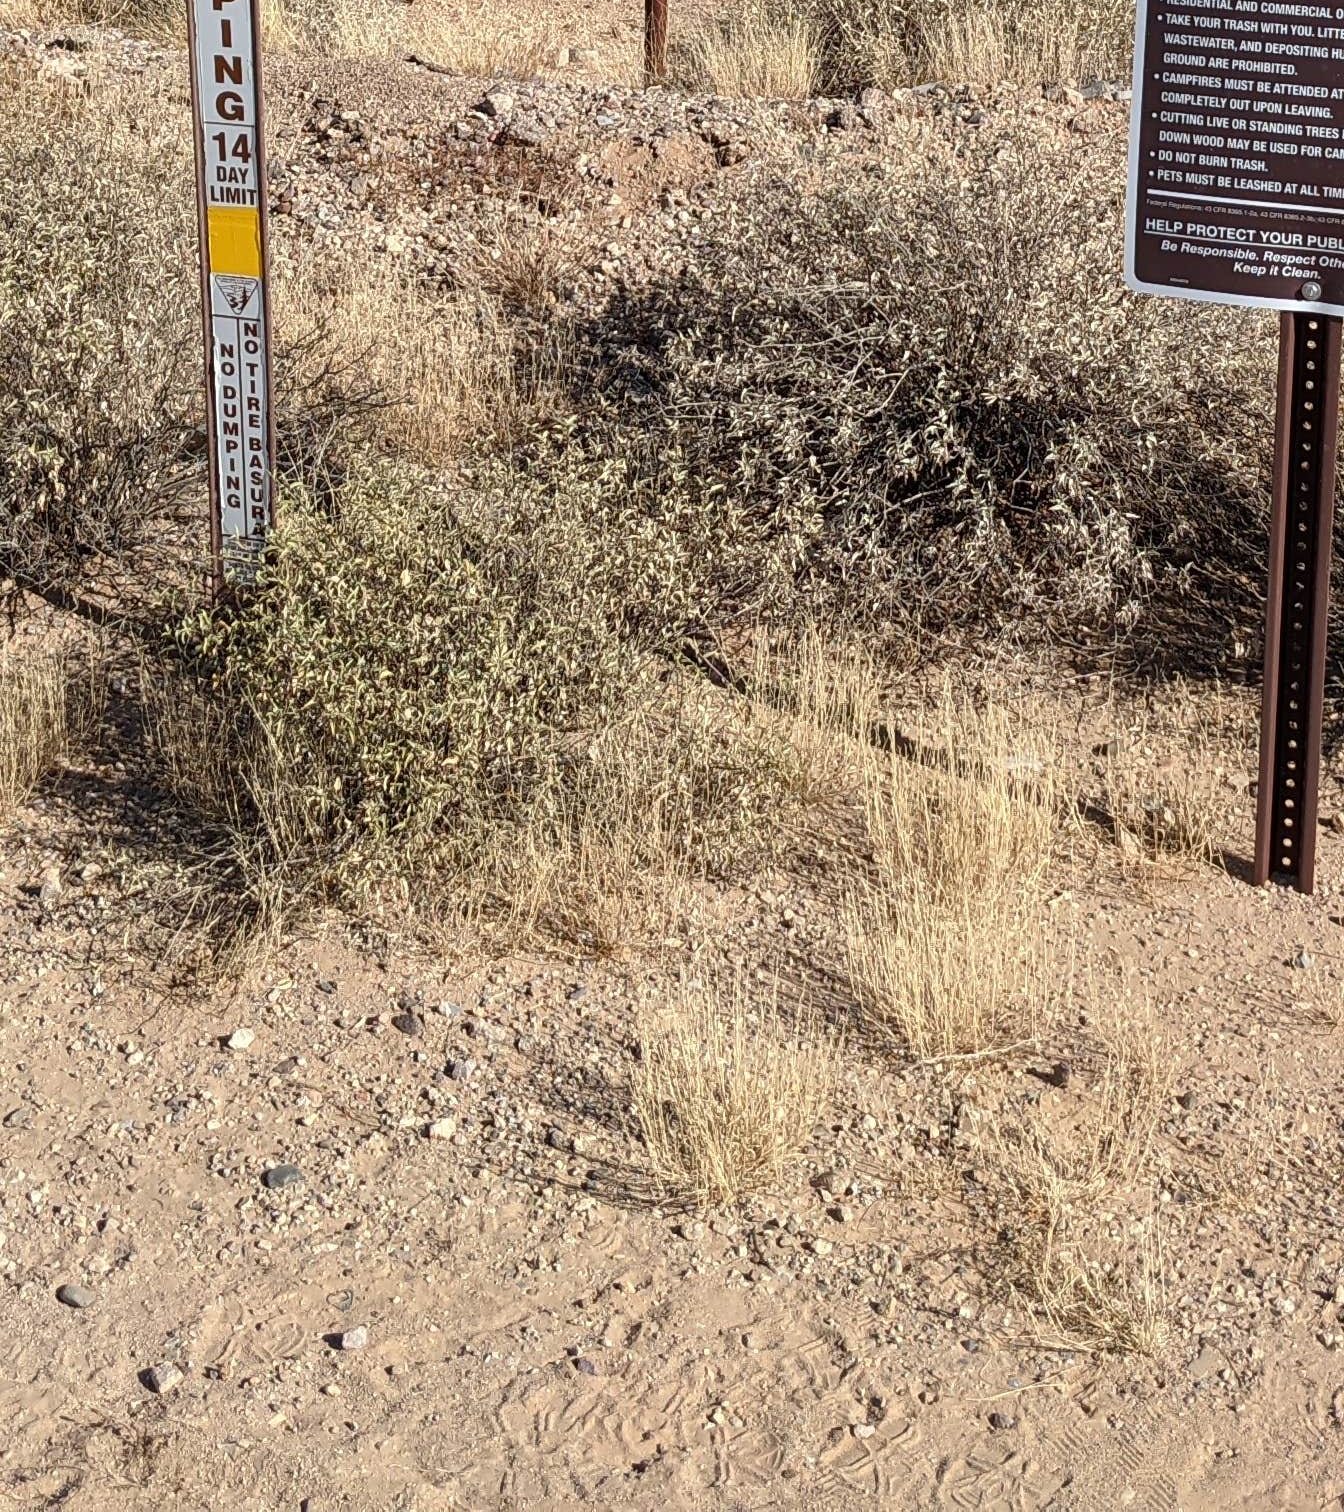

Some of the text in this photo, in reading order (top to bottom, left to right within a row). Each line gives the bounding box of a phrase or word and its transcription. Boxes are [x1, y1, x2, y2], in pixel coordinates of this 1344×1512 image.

[1234, 0, 1259, 13] AND
[1260, 1, 1334, 19] COMMERCIAL
[1165, 13, 1192, 26] TAKE
[1192, 15, 1222, 30] YOUR
[1223, 18, 1259, 33] TRASH
[1260, 21, 1289, 35] WITH
[1290, 24, 1316, 38] YOU.
[1163, 33, 1238, 52] WASTEWATER,
[1238, 39, 1263, 53] AND
[1264, 42, 1329, 59] DEPOSITING
[1163, 52, 1299, 76] GROUND ARE PROHIBITED.
[1162, 72, 1222, 89] CAMPFIRES
[1224, 78, 1255, 92] MUST
[1256, 81, 1272, 94] BE
[1272, 82, 1329, 99] ATTENDED
[1330, 87, 1344, 100] AT
[1161, 91, 1334, 119] COMPLETELY OUT UPON LEAVING.
[1160, 111, 1204, 126] CUTTING
[1206, 115, 1230, 129] LIVE
[1231, 118, 1247, 131] OR
[1248, 120, 1304, 136] STANDING
[1304, 125, 1340, 140] TREES
[212, 131, 251, 164] 14
[1159, 130, 1191, 145] DOWN
[1192, 133, 1225, 148] WOOD
[1226, 137, 1251, 151] MAY
[1252, 140, 1268, 153] BE
[1269, 141, 1299, 156] USED
[1300, 144, 1323, 158] FOR
[216, 165, 249, 184] DAY
[1158, 150, 1269, 172] DO NOT BURN TRASH.
[210, 185, 257, 206] LIMIT
[1157, 169, 1183, 183] PETS
[1185, 172, 1216, 186] MUST
[1217, 175, 1232, 188] BE
[1233, 177, 1283, 193] LEASHED
[1283, 182, 1299, 195] AT
[1299, 184, 1321, 197] ALL
[1144, 217, 1184, 234] HELP
[1186, 222, 1257, 242] PROTECT
[1259, 230, 1304, 247] YOUR
[1160, 239, 1178, 252] Be
[1180, 241, 1260, 262] Responsible.
[1262, 250, 1317, 267] Respect
[1233, 261, 1322, 280] Keep it Clean.
[220, 343, 241, 509] NO DUMPING
[244, 322, 265, 538] NO TIRE BASURA
